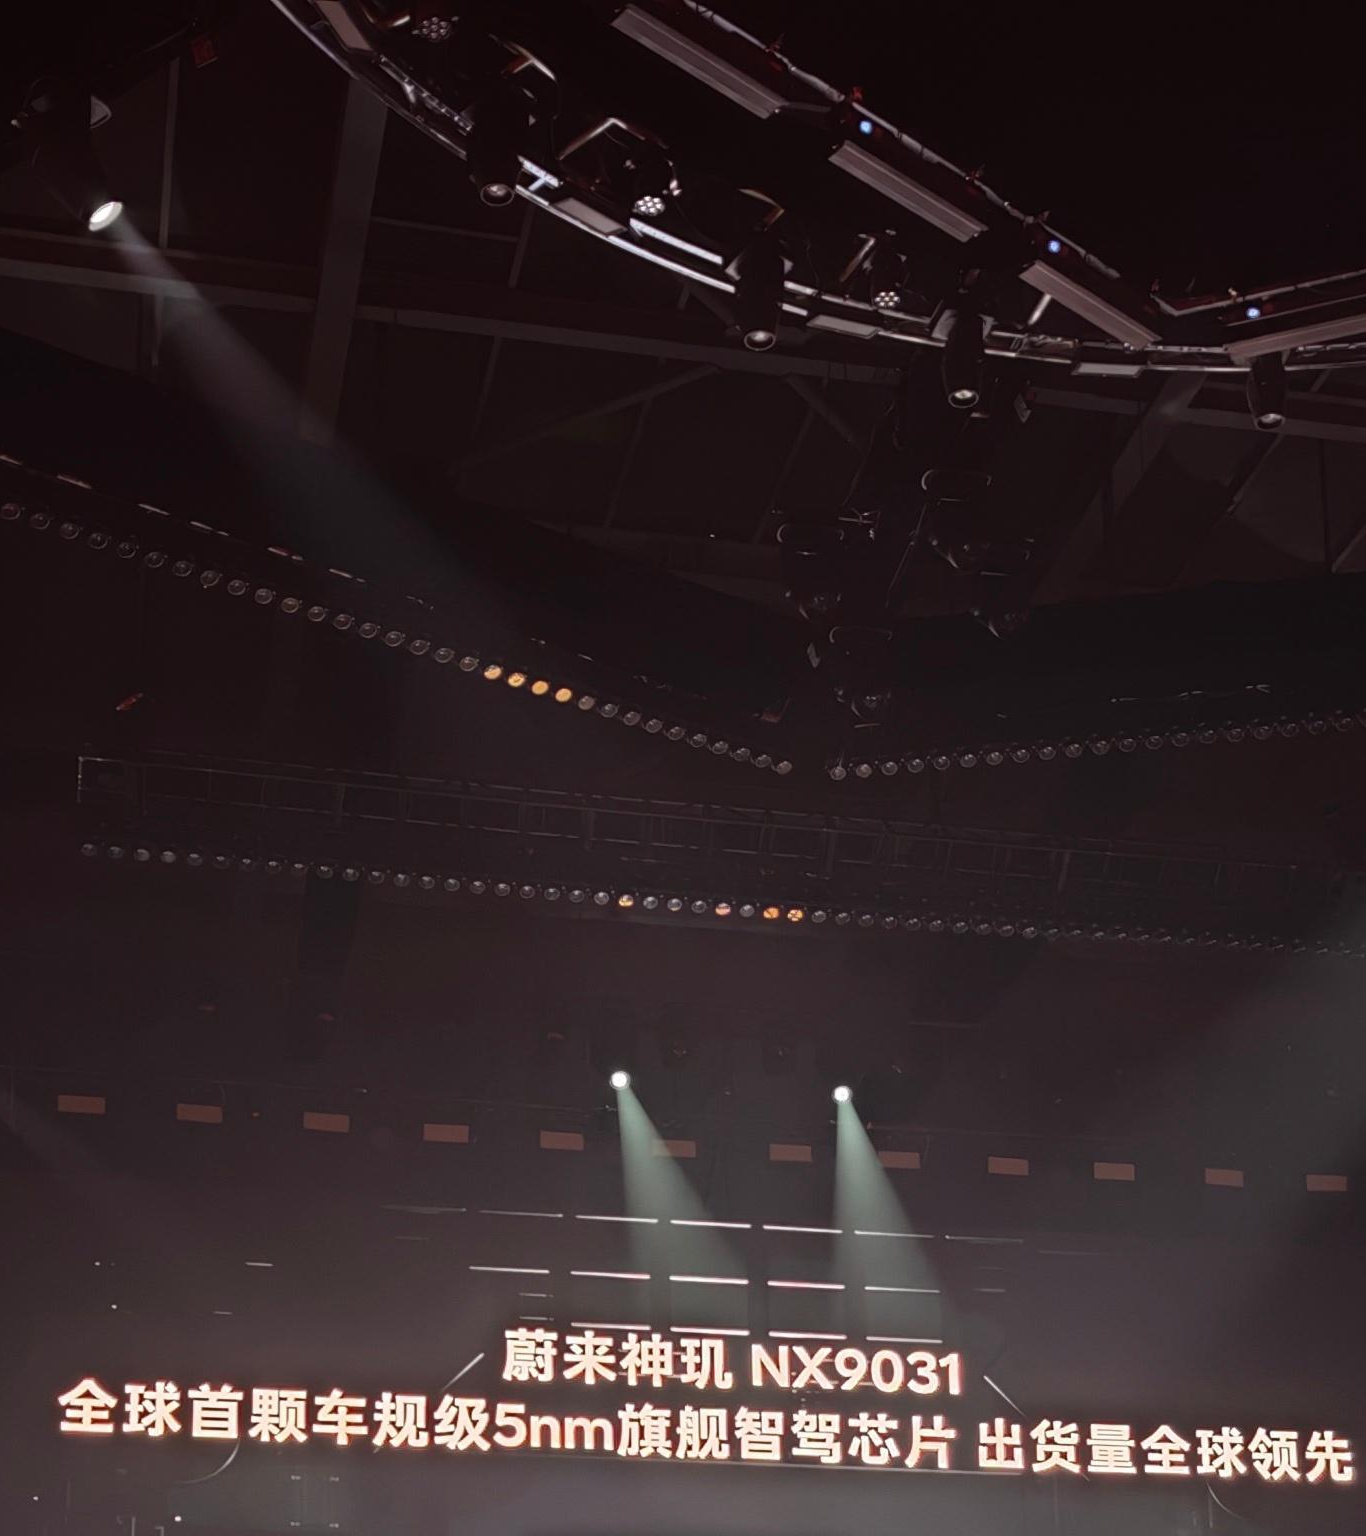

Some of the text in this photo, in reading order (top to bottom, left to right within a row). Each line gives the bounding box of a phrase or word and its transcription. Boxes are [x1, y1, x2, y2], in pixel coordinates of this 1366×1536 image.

[502, 1327, 961, 1396] 蔚来神玑 NX9031
[57, 1377, 1355, 1483] 全球首颗车规级5nm旗舰智驾芯片 出货量全球领先
